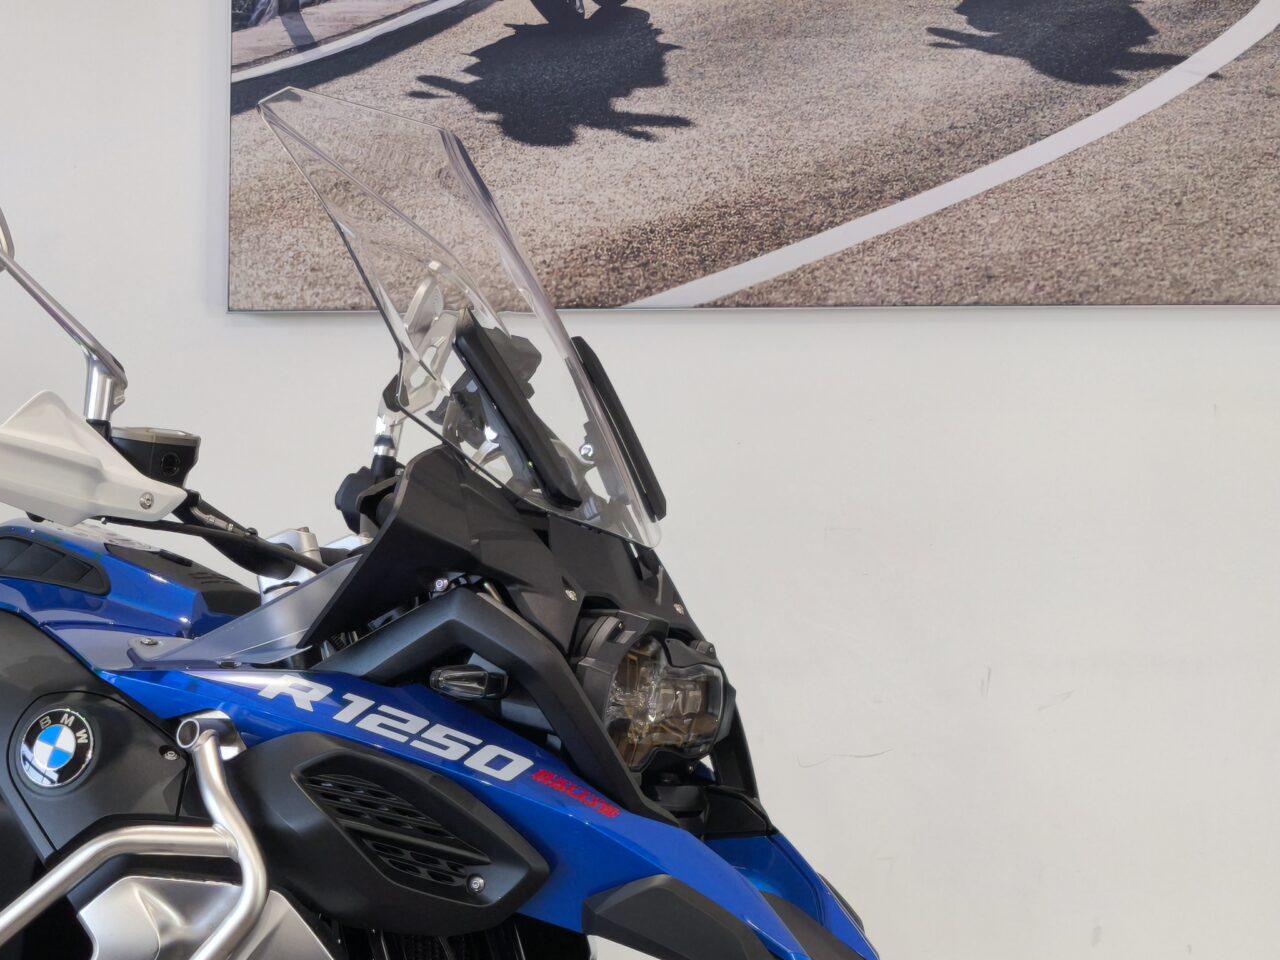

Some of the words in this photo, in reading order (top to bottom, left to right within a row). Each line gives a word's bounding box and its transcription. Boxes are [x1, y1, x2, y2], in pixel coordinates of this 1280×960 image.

[38, 712, 90, 744] BMW
[257, 674, 333, 712] R
[332, 692, 535, 782] 1250
